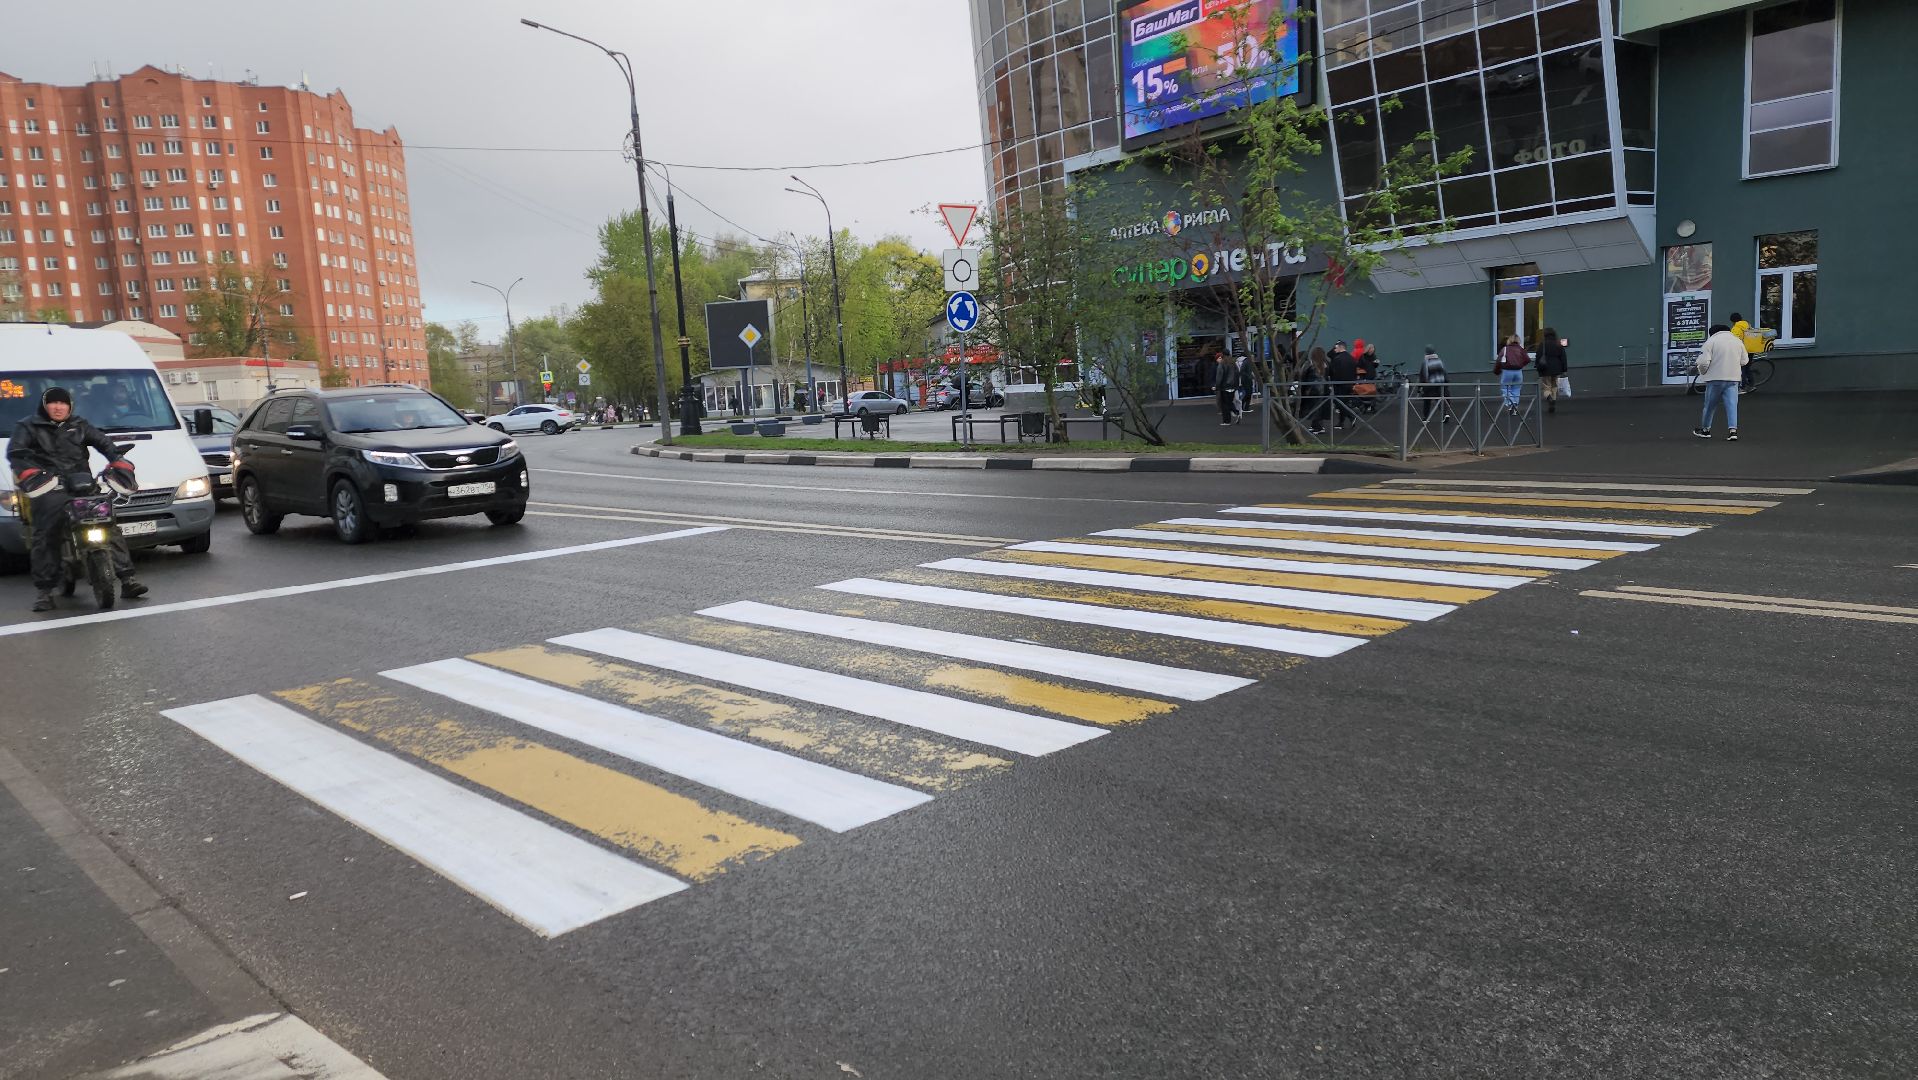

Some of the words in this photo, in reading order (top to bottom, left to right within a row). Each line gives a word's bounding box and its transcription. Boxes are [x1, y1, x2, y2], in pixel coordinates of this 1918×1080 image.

[1134, 7, 1199, 39] БашМаг
[1131, 65, 1179, 103] 15%
[1110, 220, 1160, 242] АПТЕКА
[1184, 208, 1231, 229] РИГЛА
